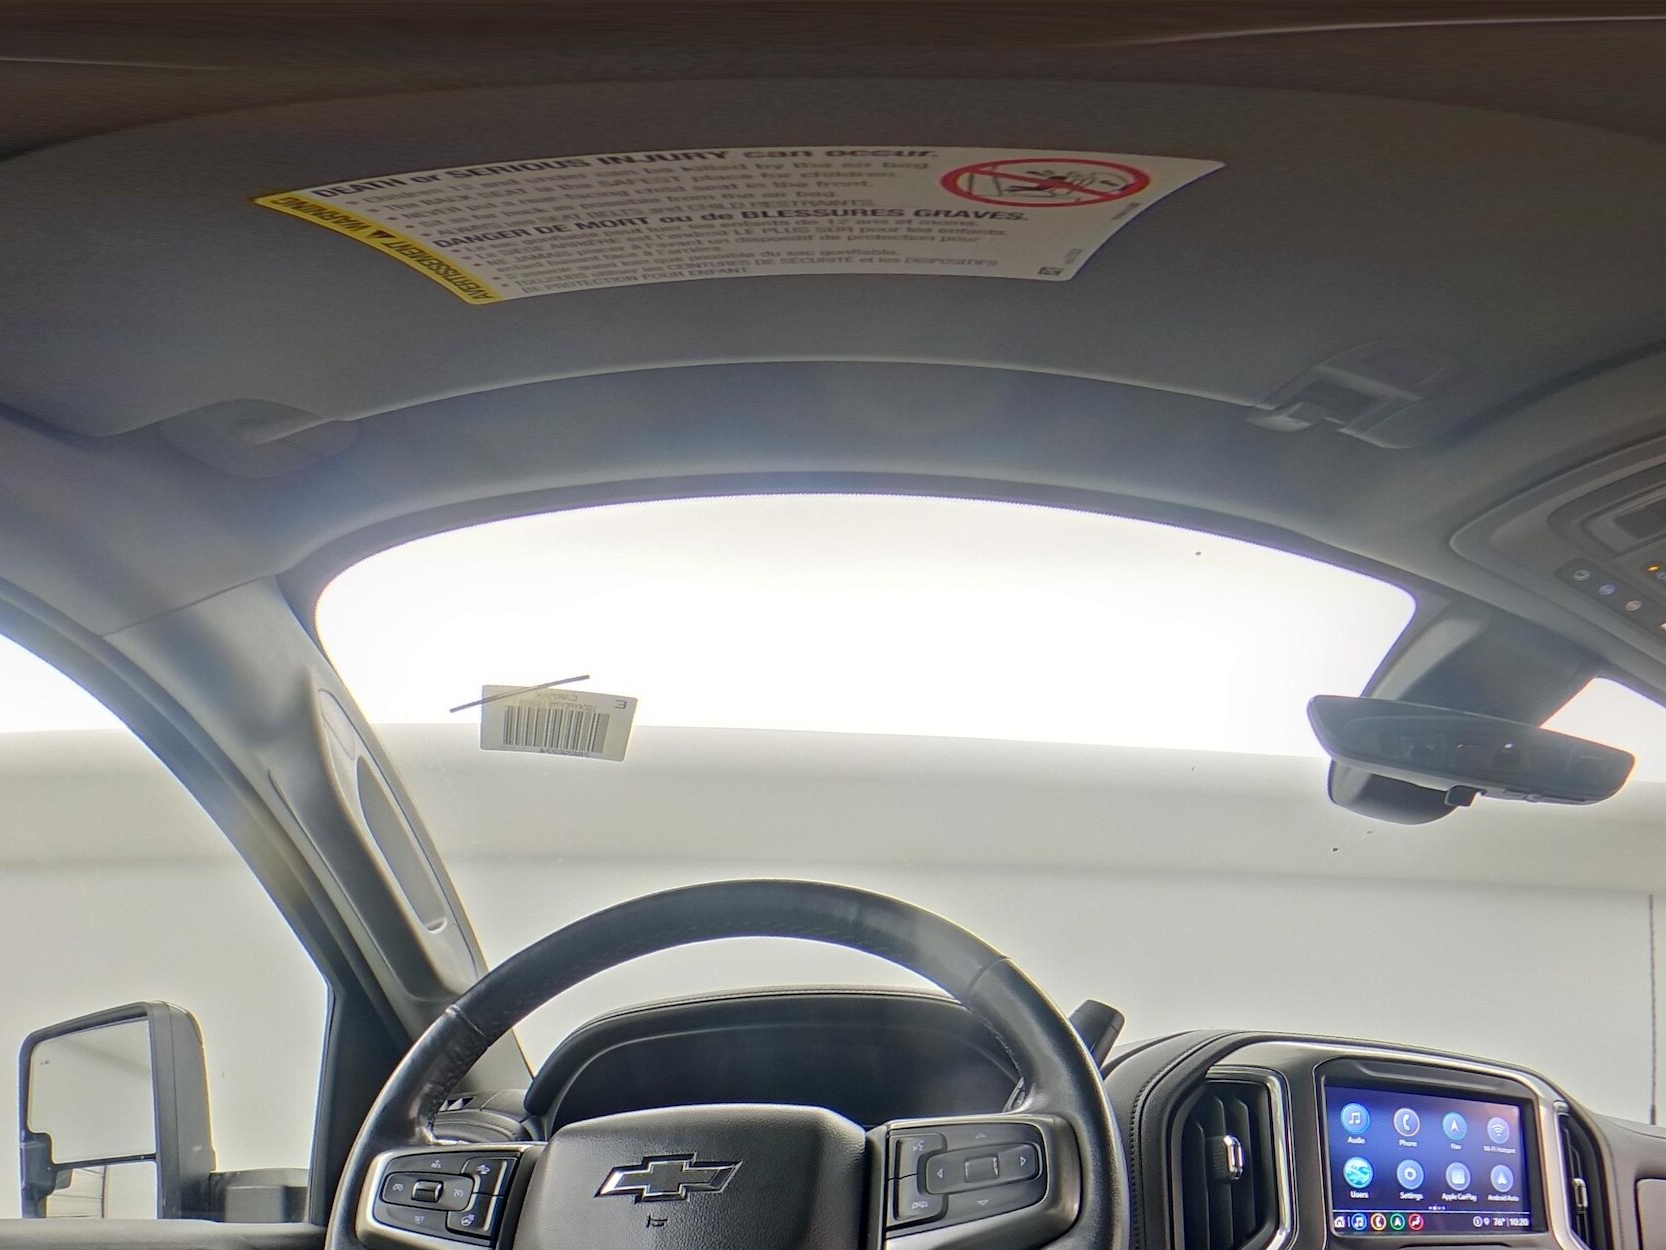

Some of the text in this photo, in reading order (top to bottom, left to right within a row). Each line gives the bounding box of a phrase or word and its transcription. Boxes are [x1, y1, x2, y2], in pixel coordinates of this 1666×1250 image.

[311, 179, 408, 197] DEATH
[409, 175, 441, 183] or
[445, 160, 591, 178] SERIOUS
[597, 151, 727, 164] INJURY
[272, 198, 370, 231] WARNING
[433, 229, 532, 247] DANGER
[533, 225, 572, 234] DE
[574, 217, 649, 230] MORT
[700, 213, 734, 221] de
[741, 209, 904, 218] BLESSURES
[913, 209, 1030, 220] GRAVES.
[382, 242, 492, 299] AVERTISSEMENT
[1347, 1136, 1366, 1144] Audio
[1399, 1139, 1418, 1147] Phone
[1350, 1191, 1369, 1199] Users
[1399, 1192, 1424, 1201] Settings
[1441, 1193, 1478, 1202] Apple CarPlay
